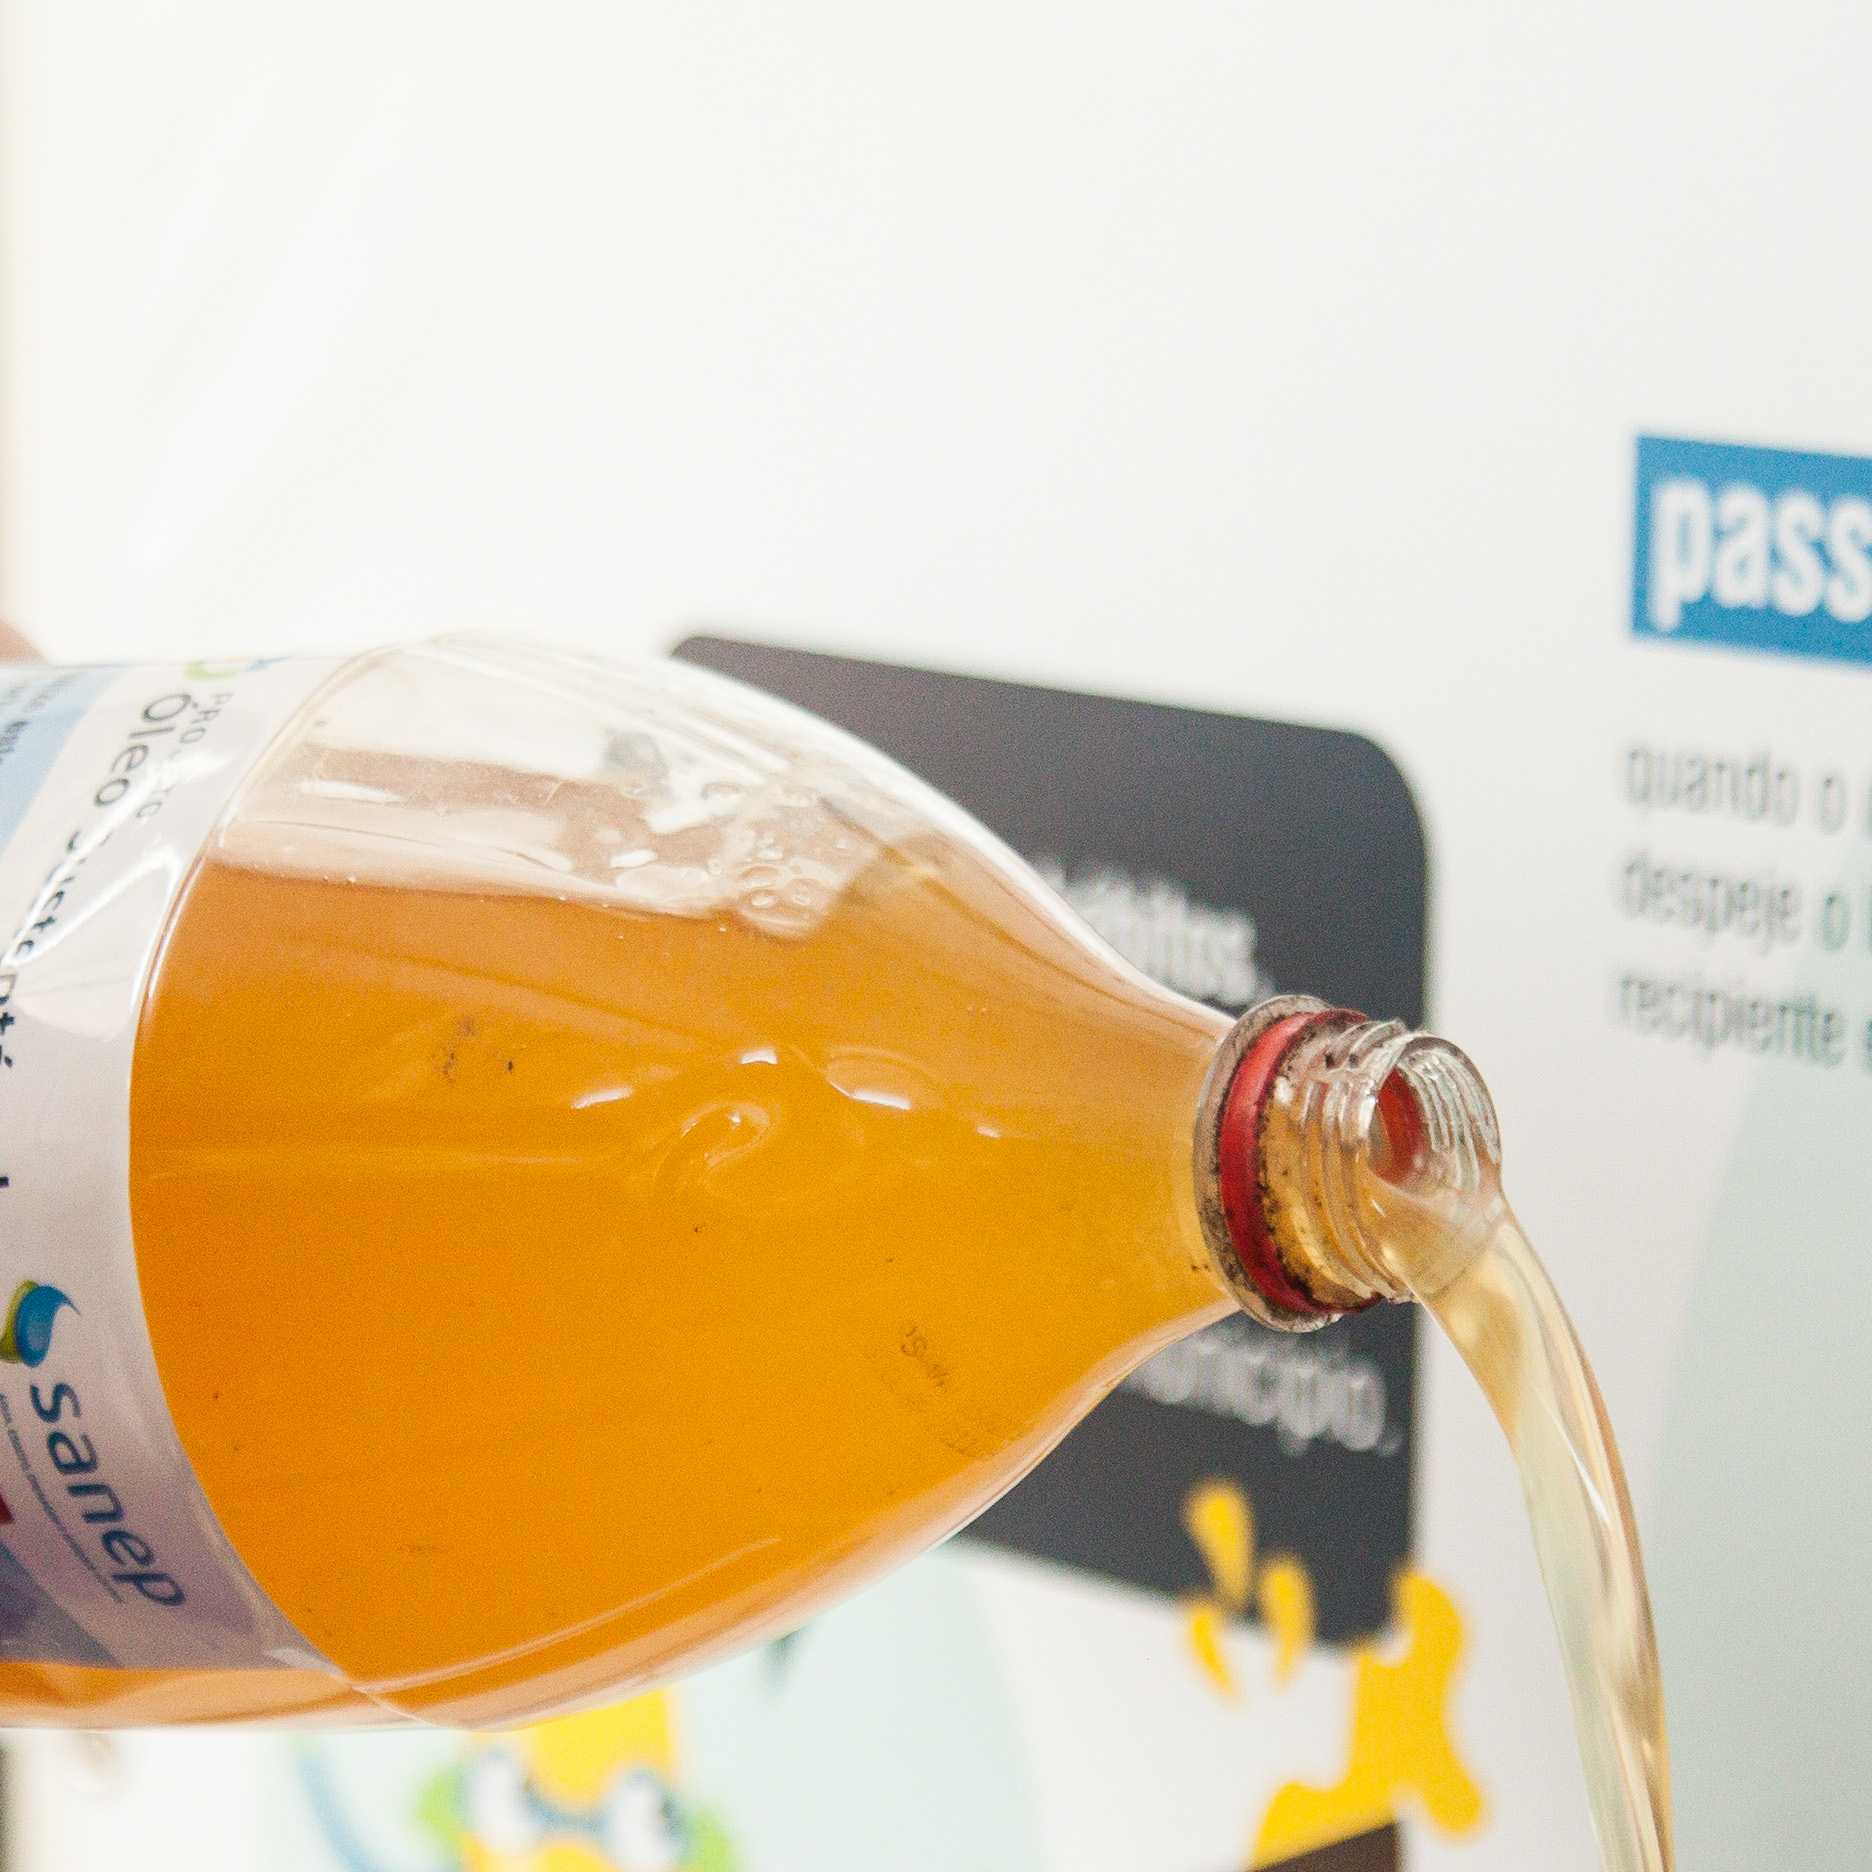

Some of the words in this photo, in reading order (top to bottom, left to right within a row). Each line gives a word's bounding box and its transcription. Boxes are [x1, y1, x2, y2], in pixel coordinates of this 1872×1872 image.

[93, 692, 201, 807] Óleo
[1623, 742, 1801, 829] quando
[1819, 768, 1848, 832] o
[1620, 850, 1800, 947] despeje
[1819, 888, 1850, 951] o
[1614, 968, 1844, 1068] recipiente
[29, 1379, 187, 1610] sanep
